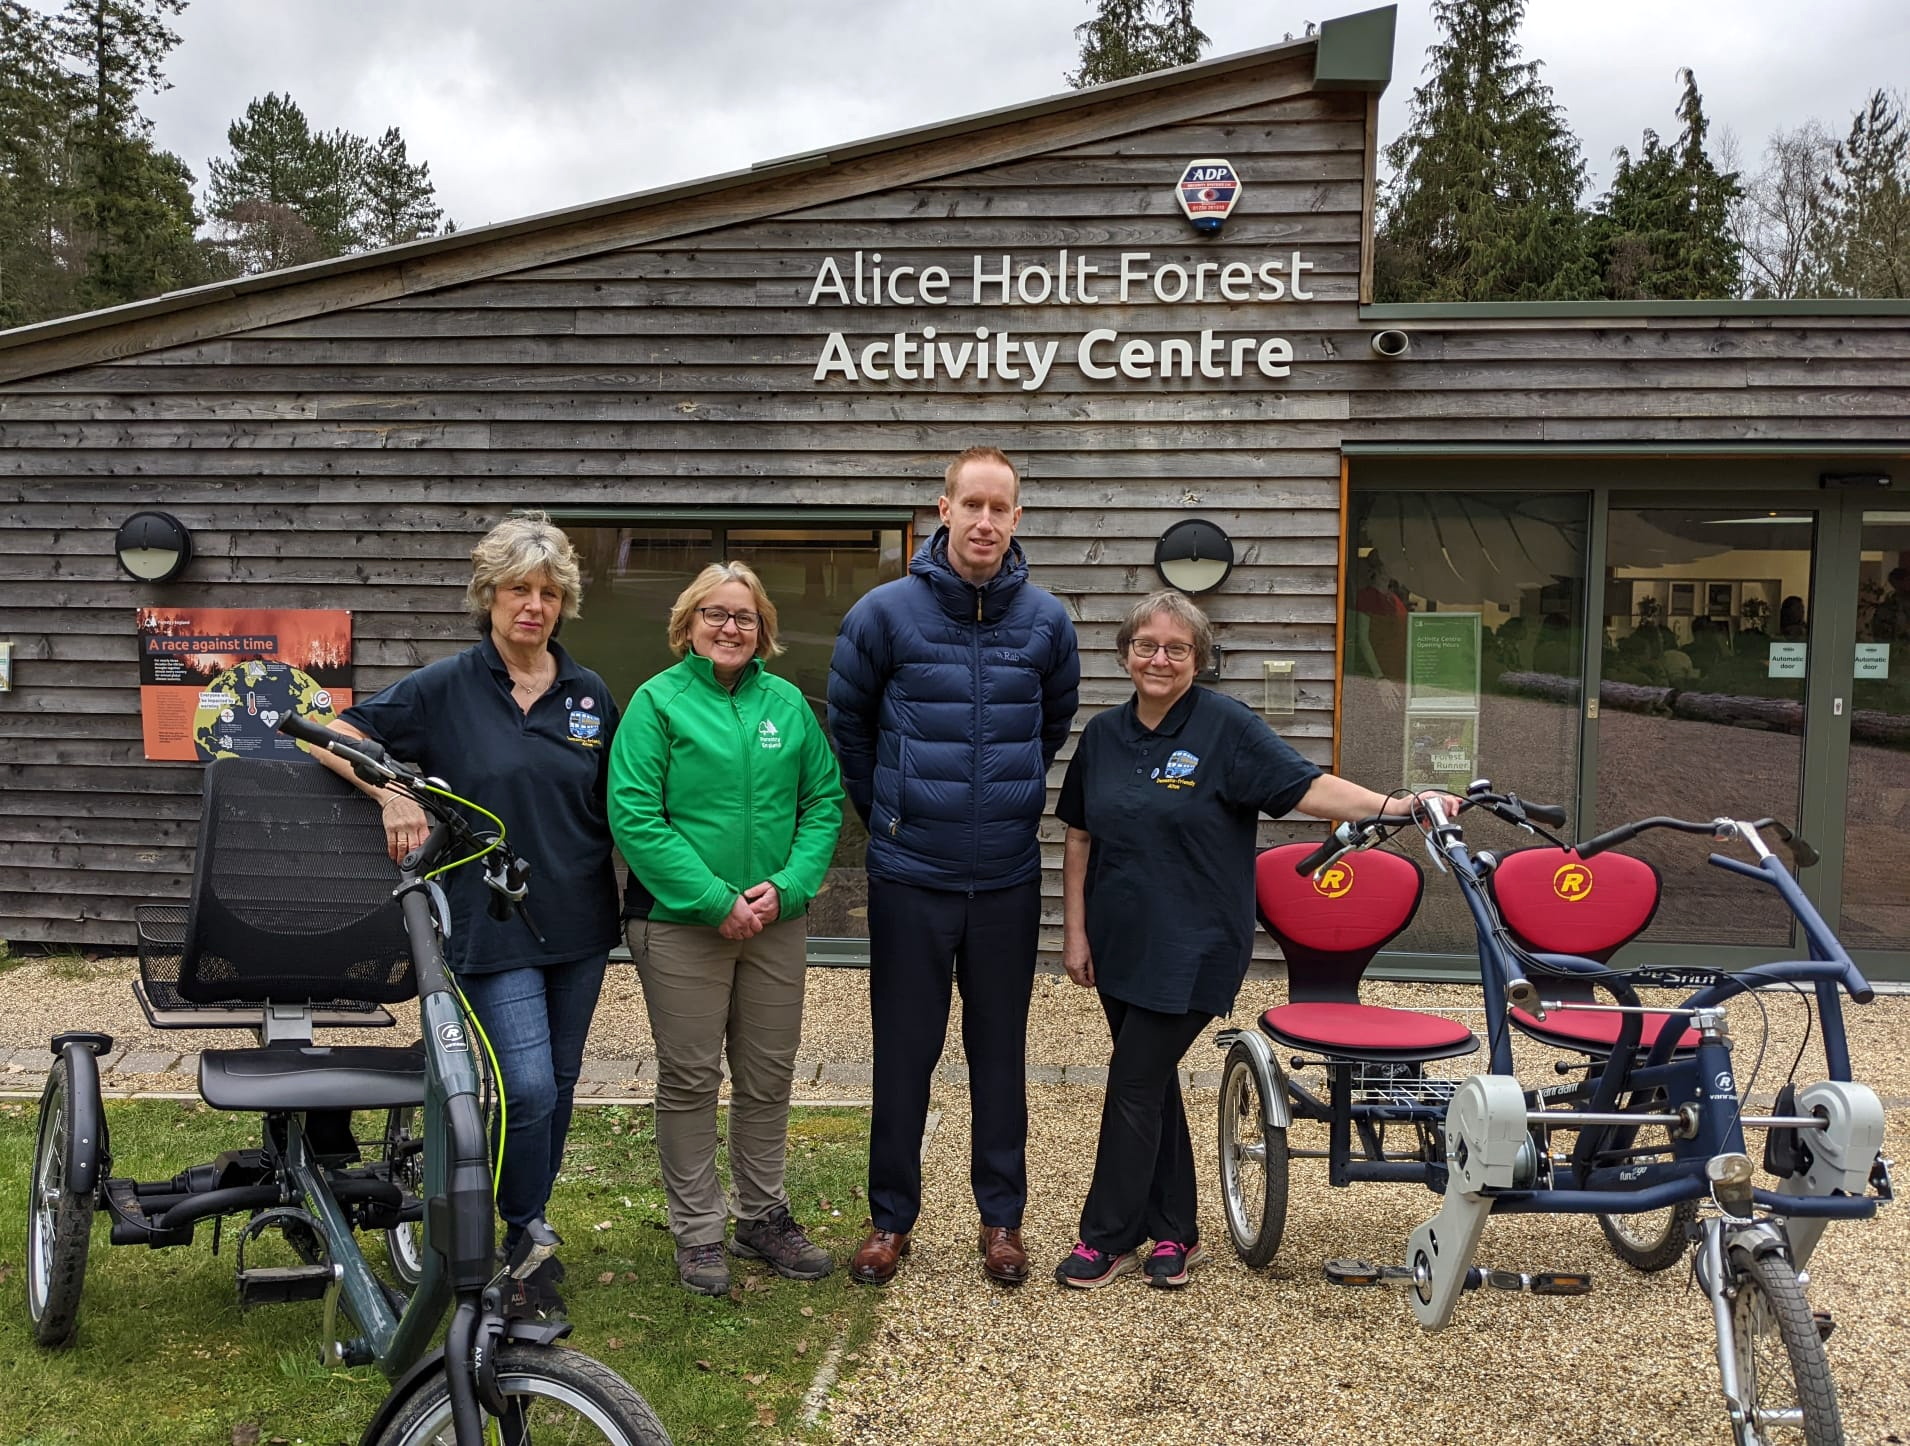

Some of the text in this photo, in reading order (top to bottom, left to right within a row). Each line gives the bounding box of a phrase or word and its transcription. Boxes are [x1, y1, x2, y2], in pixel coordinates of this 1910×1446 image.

[1193, 168, 1227, 180] ADP
[808, 248, 1315, 306] Alice Holt Forest
[813, 326, 1295, 390] Activity Centre
[149, 637, 274, 652] A race against time
[1004, 651, 1020, 662] Rab
[1320, 869, 1346, 889] R
[1560, 873, 1585, 892] R
[1719, 1076, 1731, 1087] R
[475, 1346, 483, 1369] AXA
